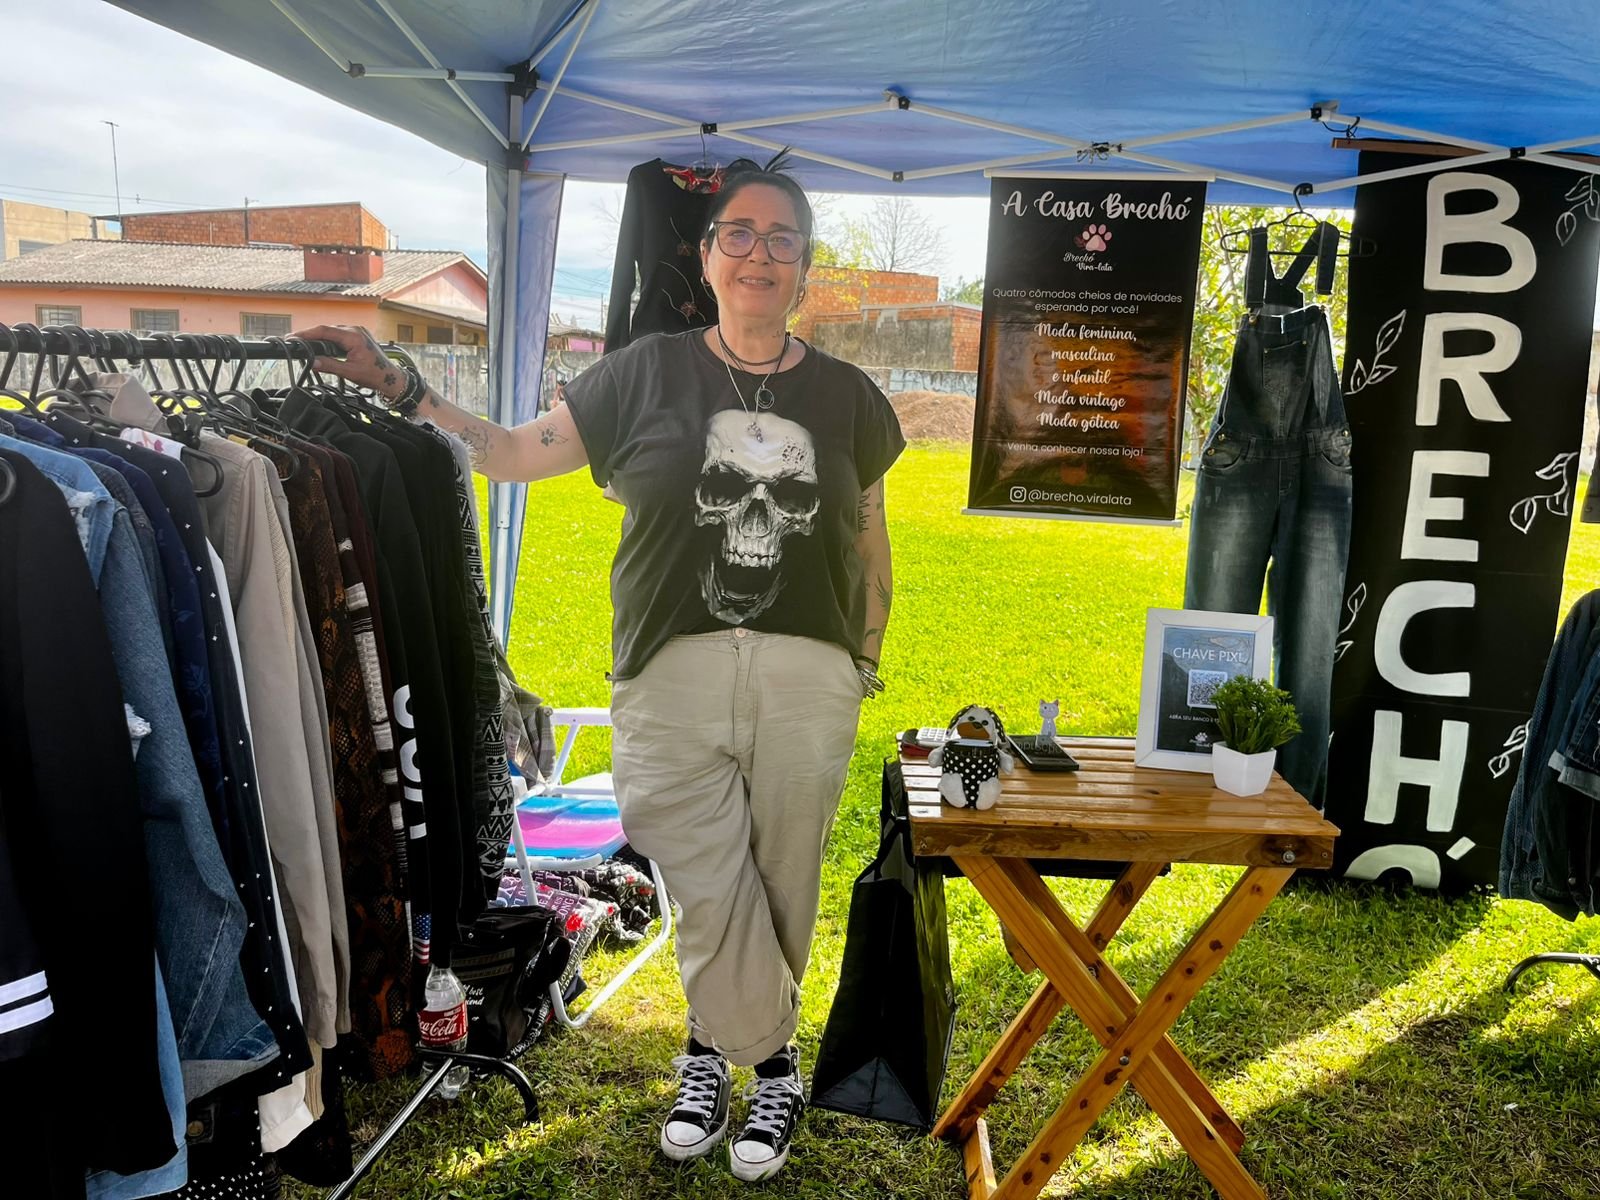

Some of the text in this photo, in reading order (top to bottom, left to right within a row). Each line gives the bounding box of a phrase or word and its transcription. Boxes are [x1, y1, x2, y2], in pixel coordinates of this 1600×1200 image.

[1001, 190, 1193, 221] A Casa Brechó
[1063, 252, 1095, 263] Brechó
[1076, 262, 1113, 272] Vira-lata
[992, 288, 1183, 304] Quatro cômodos cheios de novidades
[1034, 302, 1139, 315] esperando por você!
[1033, 322, 1137, 342] Moda feminina,
[1050, 346, 1116, 362] masculina
[1052, 369, 1112, 385] e infantil
[1033, 389, 1126, 411] Moda vintage
[1036, 412, 1120, 432] Moda gótica
[1007, 442, 1144, 458] Venha conhecer nossa loja!
[1028, 488, 1133, 506] @brecho.viralata
[1173, 647, 1215, 661] CHAVE
